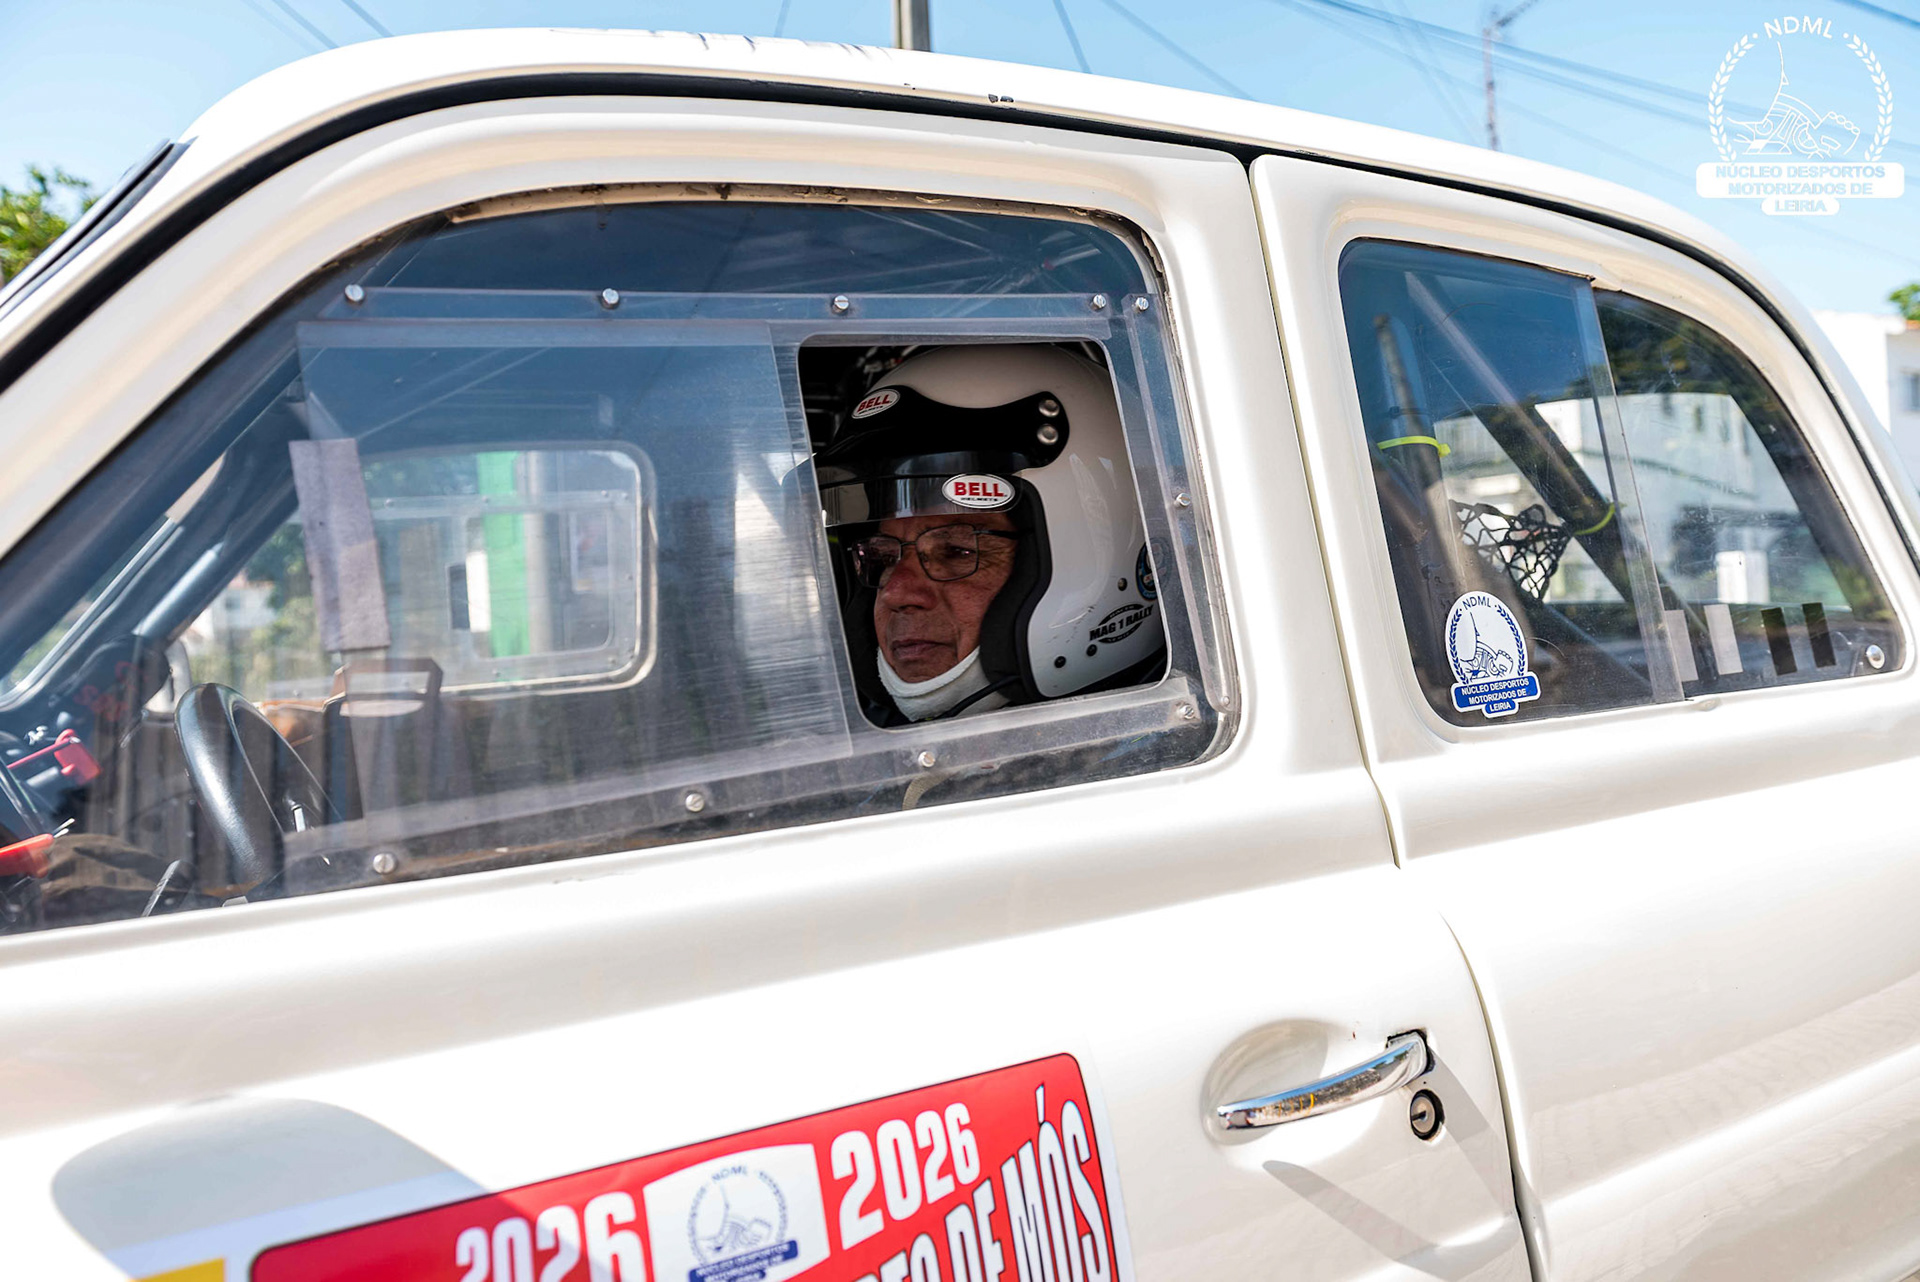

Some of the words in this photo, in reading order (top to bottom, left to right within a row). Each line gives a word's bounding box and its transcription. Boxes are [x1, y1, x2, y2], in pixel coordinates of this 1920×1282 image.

[857, 394, 890, 413] BELL
[954, 481, 1004, 497] BELL
[1462, 596, 1491, 609] NDML
[1090, 623, 1116, 640] MAG
[1119, 618, 1124, 630] 1
[1126, 605, 1154, 626] RALLY
[1461, 683, 1490, 696] NÚCLEO
[1490, 678, 1529, 692] DESPORTOS
[1468, 691, 1516, 704] MOTORIZADOS
[1489, 703, 1512, 712] LEIRIA
[830, 1102, 981, 1251] 2026
[1000, 1083, 1111, 1282] MÓS
[456, 1191, 648, 1282] 2026
